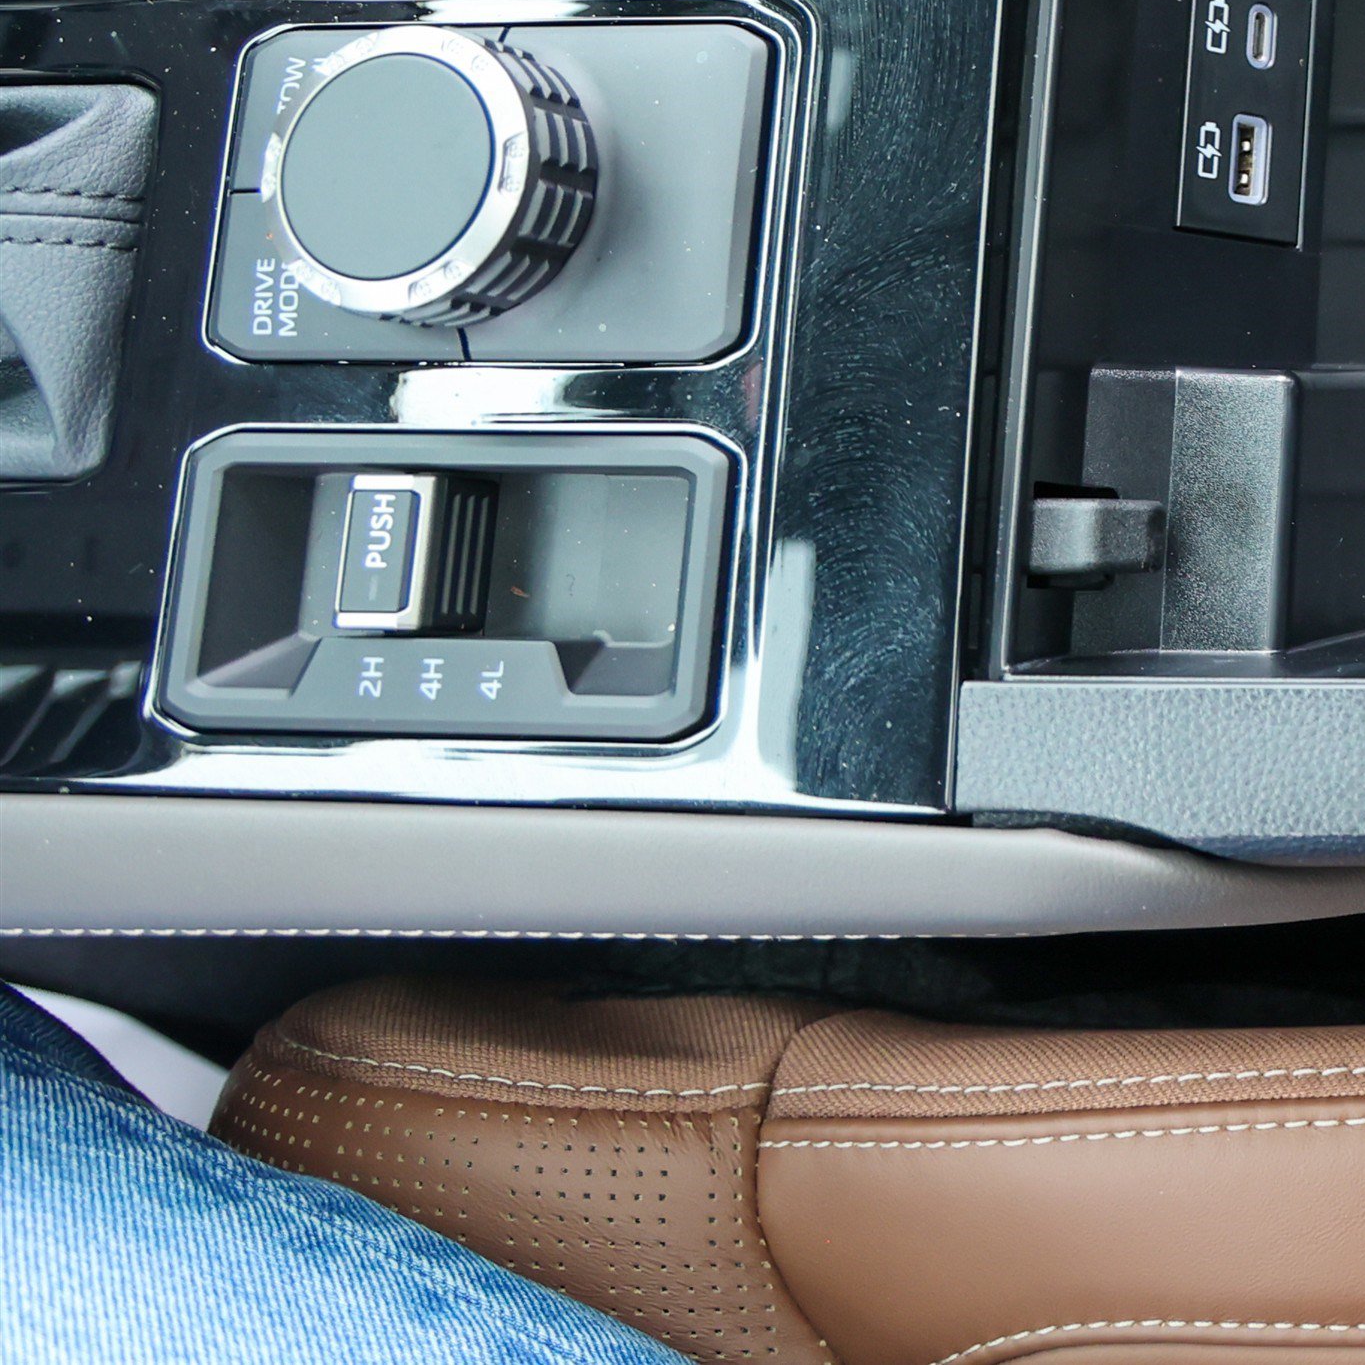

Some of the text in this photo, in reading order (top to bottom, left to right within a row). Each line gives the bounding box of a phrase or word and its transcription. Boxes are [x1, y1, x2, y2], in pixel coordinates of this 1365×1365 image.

[252, 257, 276, 335] DRIVE
[364, 493, 397, 569] PUSH
[358, 656, 385, 698] 2H
[419, 657, 445, 701] 4H
[480, 659, 505, 701] 4L
